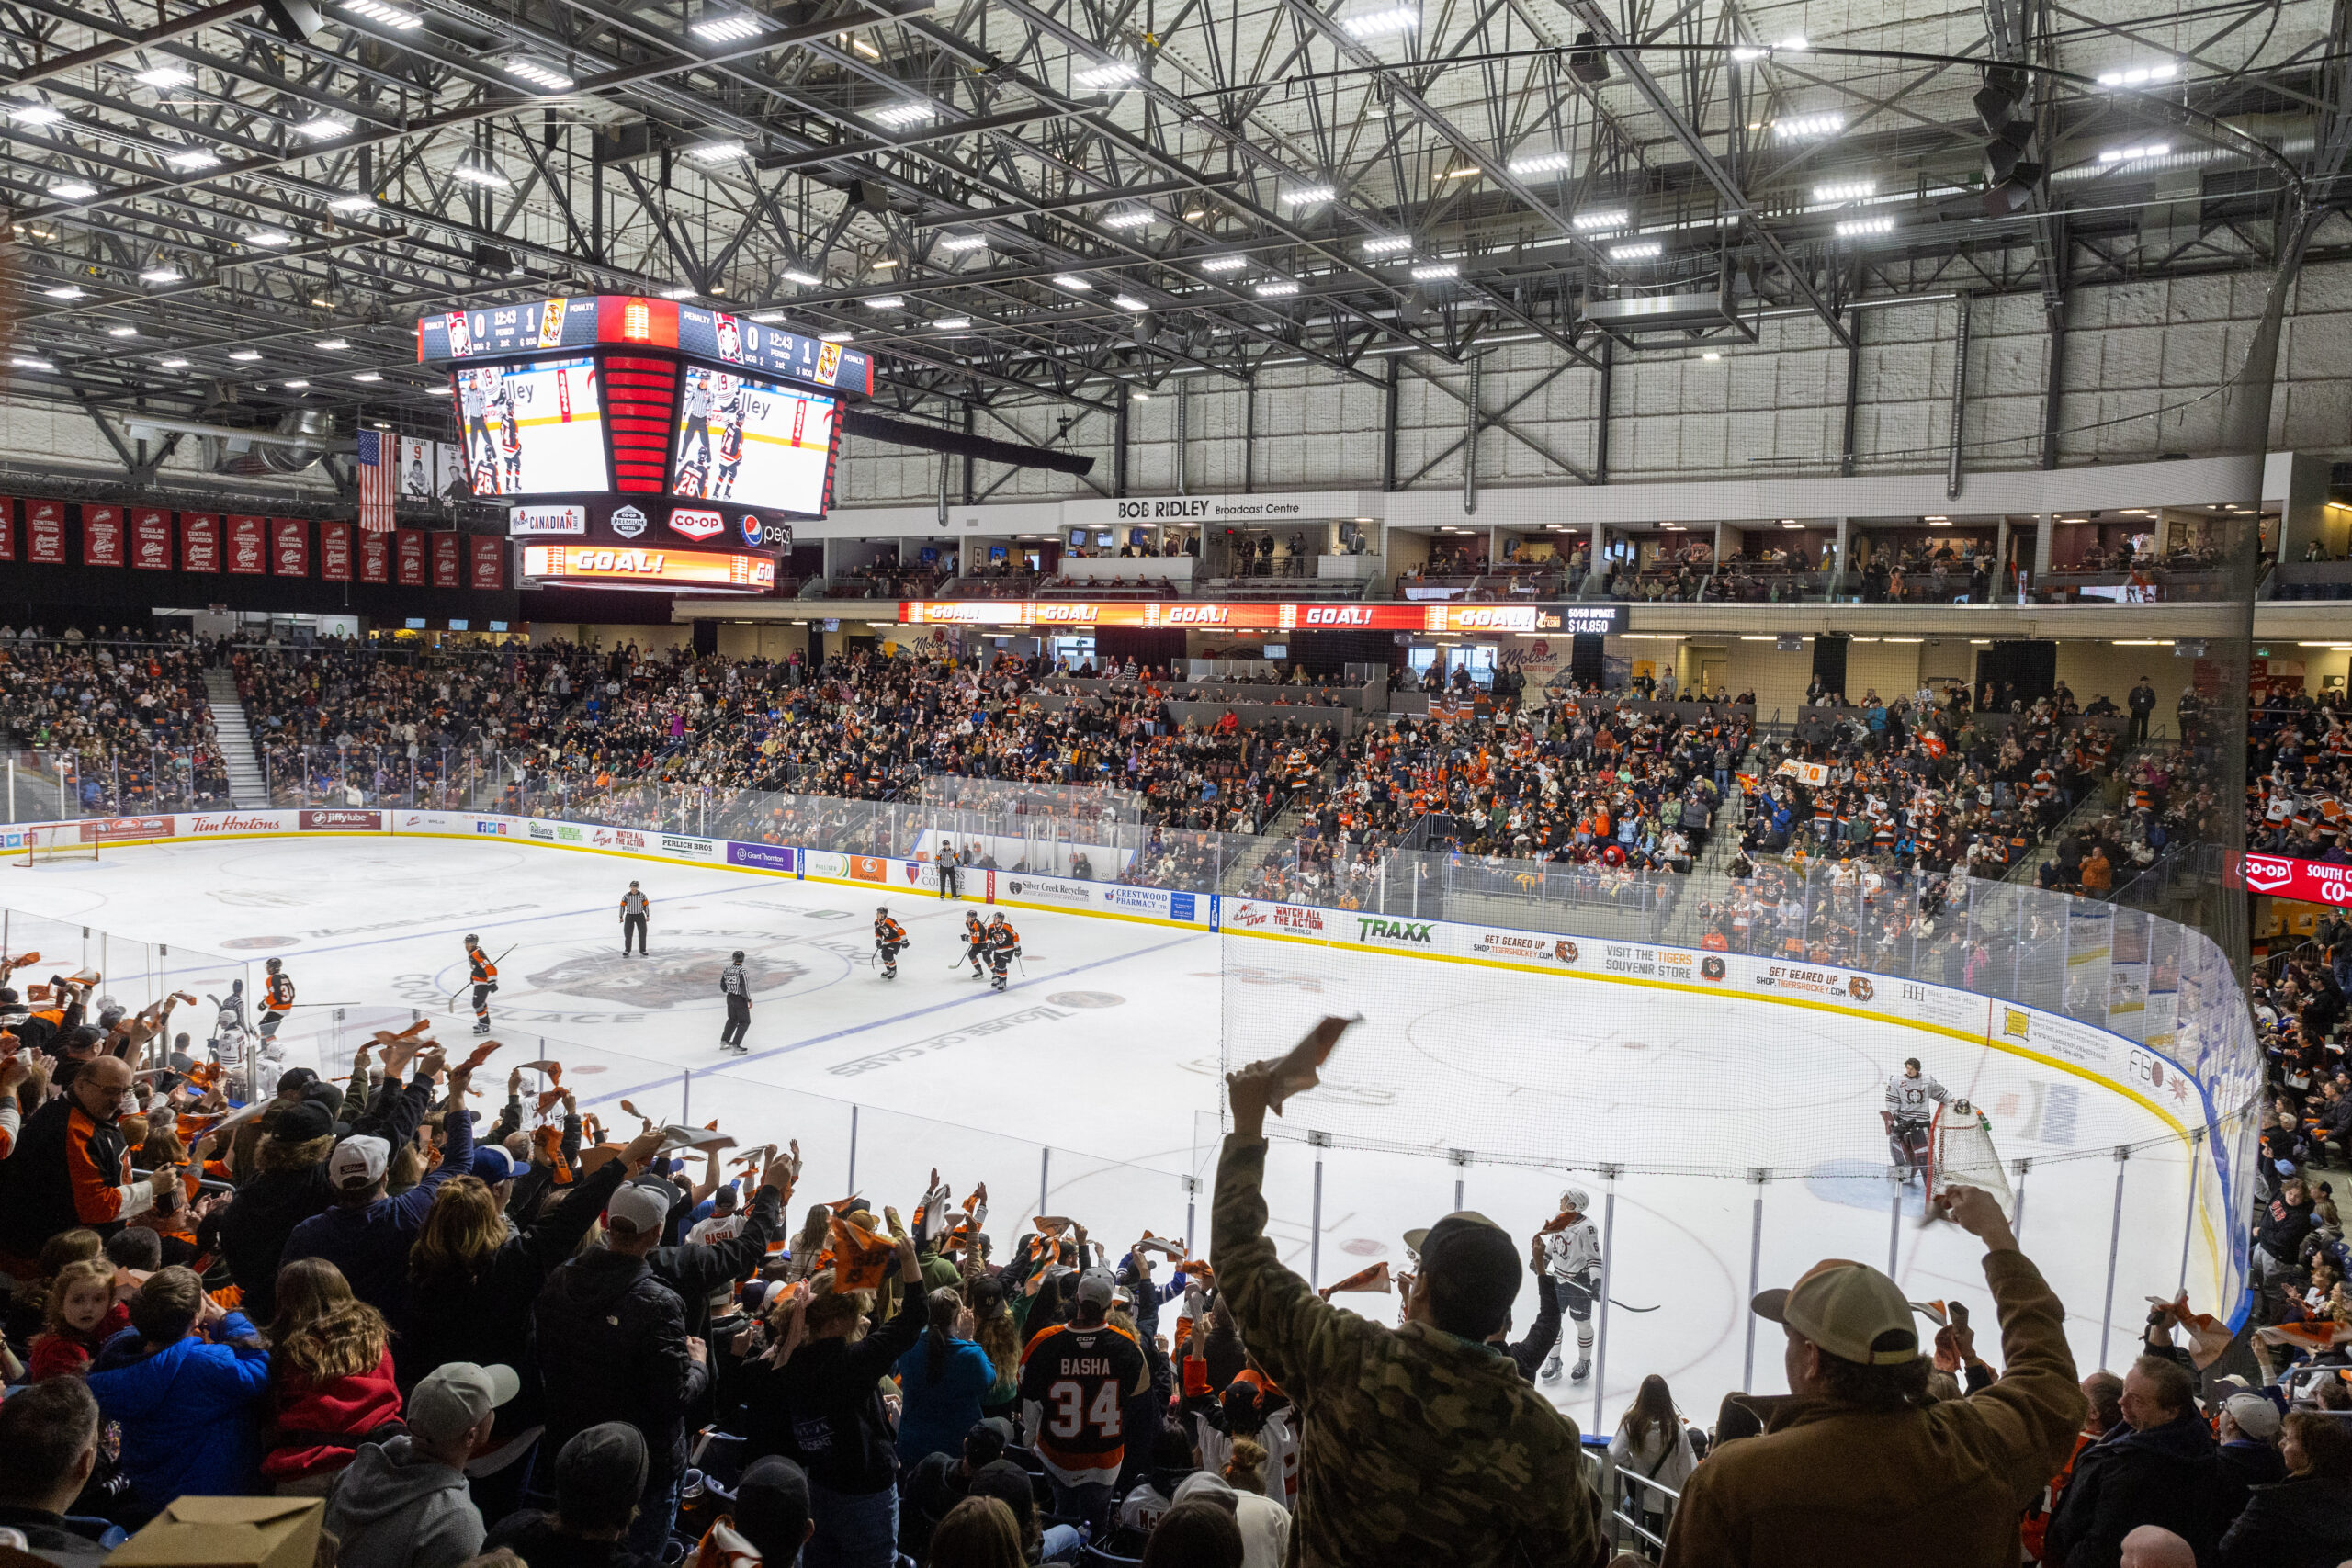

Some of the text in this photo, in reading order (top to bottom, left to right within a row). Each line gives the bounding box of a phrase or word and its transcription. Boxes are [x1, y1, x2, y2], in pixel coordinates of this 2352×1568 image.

[569, 302, 594, 313] PENALTY
[474, 313, 485, 338] 0
[494, 310, 517, 326] 12:43
[526, 308, 535, 332] 1
[684, 311, 710, 324] PENALTY
[747, 326, 758, 351] 0
[769, 332, 793, 351] 12:43
[771, 349, 790, 360] PERIOD
[802, 341, 811, 364] 1
[844, 353, 865, 366] PENALTY
[718, 374, 729, 392] 19
[413, 446, 422, 459] 9
[1118, 500, 1300, 518] BOB RIDLEY Broadcast Centre
[530, 515, 572, 530] CANADIAN
[763, 525, 792, 546] pepsi
[577, 550, 664, 573] GOAL!
[931, 604, 980, 620] GOAL!
[1045, 605, 1099, 622] GOAL!
[1169, 607, 1229, 623] GOAL!
[1306, 608, 1373, 625] GOAL!
[1459, 609, 1532, 628] GOAL!
[1590, 608, 1616, 618] UPDATE
[1500, 647, 1558, 665] Molson
[1804, 763, 1820, 781] 90
[191, 816, 220, 833] Tim
[222, 814, 280, 832] Hortons
[530, 826, 553, 835] Reliance
[616, 830, 644, 840] WATCH ALL
[627, 838, 645, 848] ACTION
[662, 840, 713, 852] PERLICH BROS
[747, 852, 784, 863] Grant Thornton
[2245, 861, 2287, 879] CO-OP
[2307, 864, 2342, 881] SOUTH
[1023, 880, 1090, 897] Silver Creek Recycling
[1116, 888, 1168, 902] CRESTWOOD
[1116, 897, 1156, 908] PHARMACY
[1246, 915, 1267, 926] LIVE
[1275, 906, 1322, 920] WATCH ALL
[1273, 916, 1323, 930] THE ACTION
[1357, 918, 1437, 942] TRAXX
[1484, 934, 1546, 950] GET GEARED UP
[1473, 943, 1554, 961] SHOP.TIGERSHOCKEY.COM
[1606, 945, 1692, 965] VISIT THE TIGERS
[1606, 959, 1691, 979] SOUVENIR STORE
[1769, 966, 1838, 986] GET GEARED UP
[1756, 976, 1847, 998] SHOP.TIGERSHOCKEY.COM
[1903, 984, 1925, 1002] HH
[705, 1230, 734, 1245] BASHA
[1060, 1358, 1111, 1375] BASHA
[1049, 1379, 1123, 1438] 34
